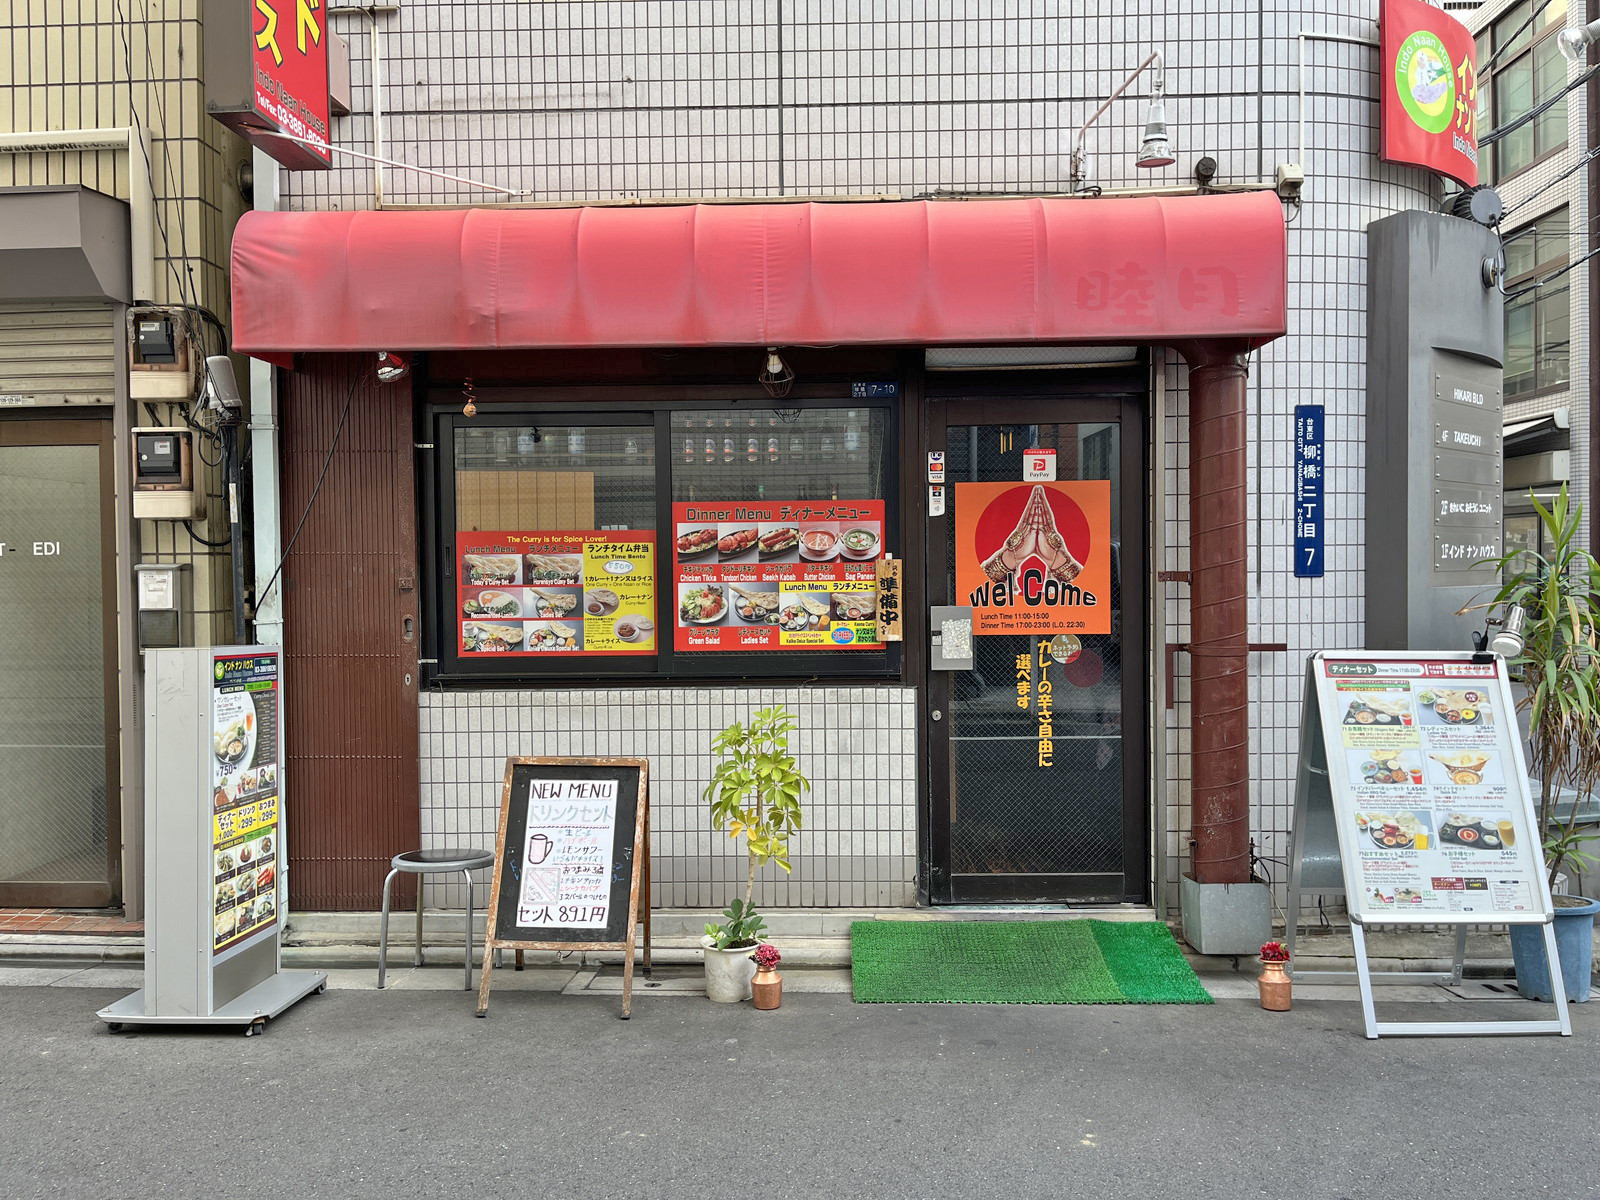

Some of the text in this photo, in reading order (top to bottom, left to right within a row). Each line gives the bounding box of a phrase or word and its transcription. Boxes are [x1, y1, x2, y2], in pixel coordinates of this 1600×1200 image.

[1398, 35, 1453, 88] Indo Naan House
[255, 62, 326, 136] Indo Naan House
[1454, 388, 1483, 405] HIKARI BLD
[1306, 418, 1314, 440] 台東区
[1453, 431, 1481, 447] TAKEUCHI
[780, 506, 871, 520] ディナーメニュー
[1303, 444, 1317, 566] 柳橋二丁目 7
[687, 508, 771, 520] Dinner Menu
[522, 536, 541, 544] Curry
[33, 542, 60, 556] EDI
[465, 545, 516, 553] Lunch Menu
[529, 544, 579, 553] ランチメニュー
[587, 544, 649, 553] ランチタイム弁当
[1449, 544, 1464, 559] インド
[1467, 544, 1478, 558] ナン
[1480, 544, 1496, 557] ハウス
[845, 573, 856, 581] Sag
[879, 577, 899, 626] 準備中
[1332, 665, 1373, 673] ディナーセット
[1015, 654, 1032, 710] 選べます
[1037, 640, 1053, 767] カレーの辛さ自由に
[531, 783, 612, 799] NEW MENU
[529, 805, 614, 823] ドリンクセット
[562, 846, 603, 855] レモンサワー
[518, 905, 606, 924] セット 891円
